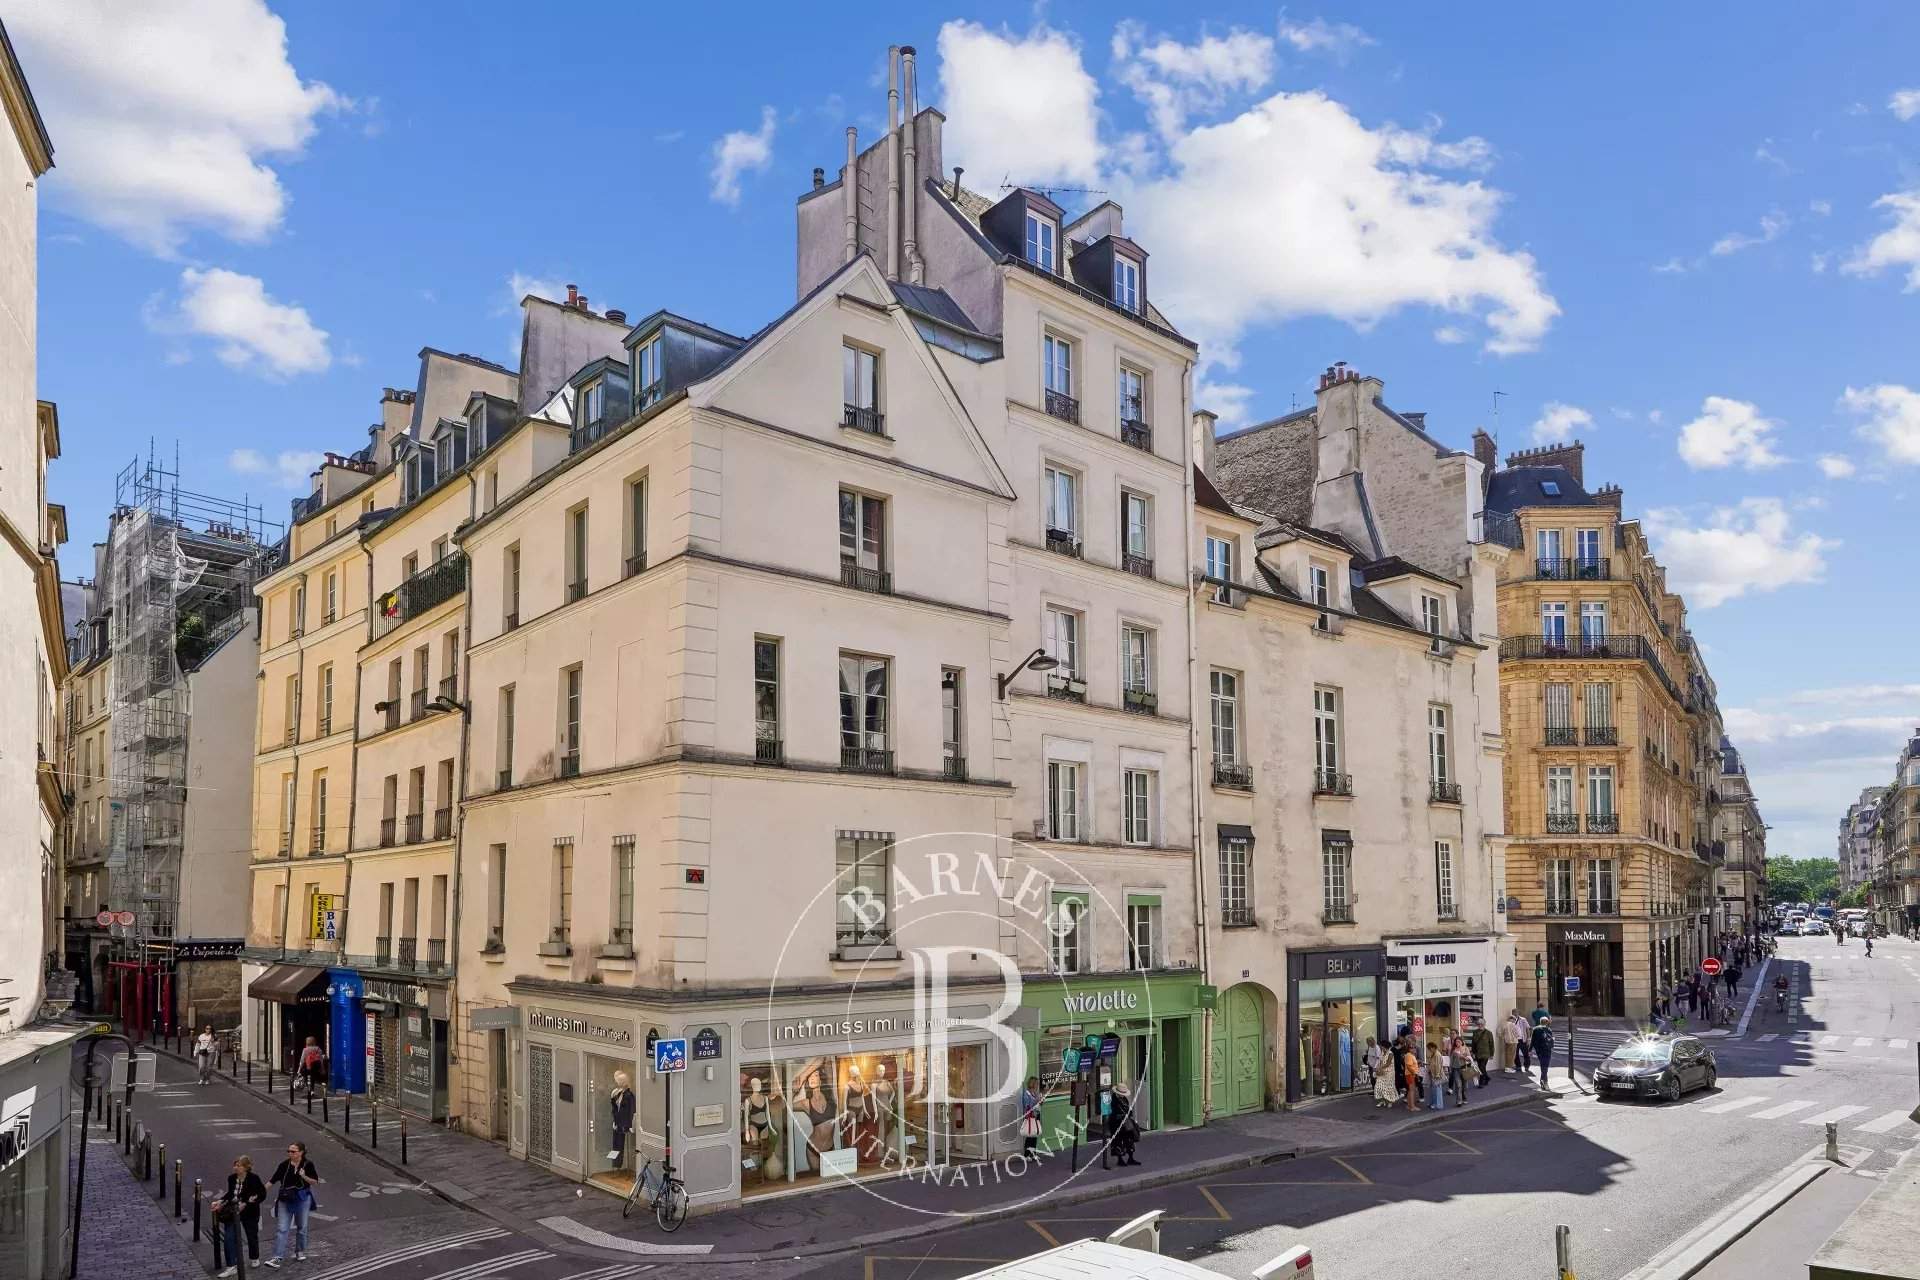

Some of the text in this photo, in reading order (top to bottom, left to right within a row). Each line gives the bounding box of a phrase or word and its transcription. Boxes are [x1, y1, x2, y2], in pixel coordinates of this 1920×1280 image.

[326, 911, 336, 939] BAR
[1564, 930, 1605, 941] MaxMara
[1424, 953, 1456, 965] BATEAU
[1041, 1071, 1063, 1080] COFFEE
